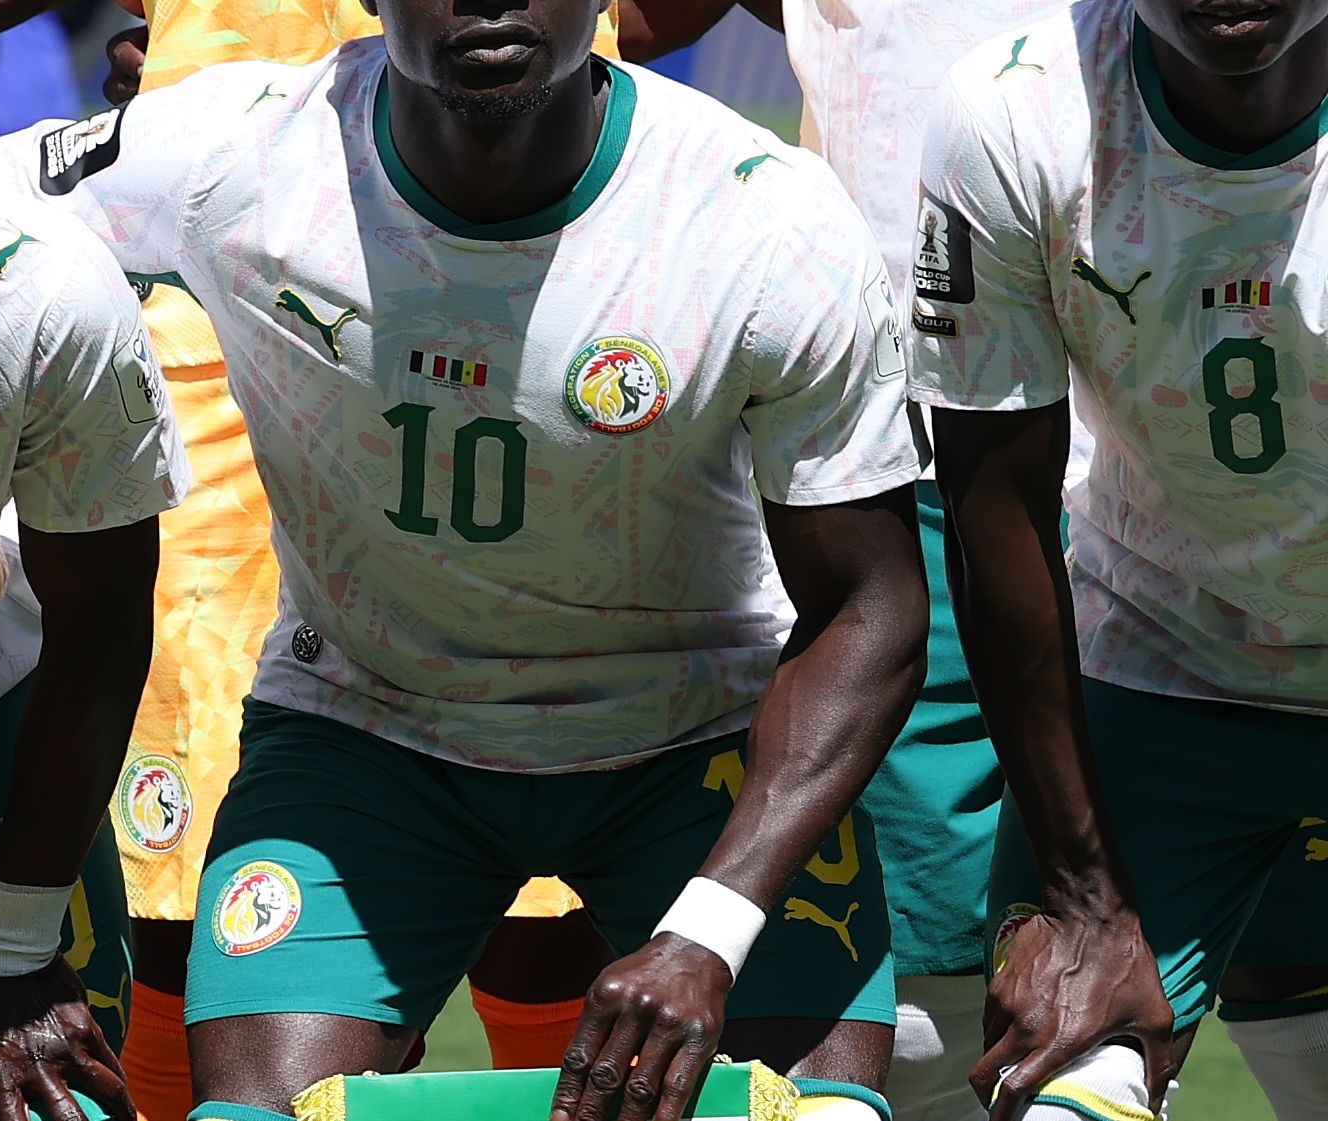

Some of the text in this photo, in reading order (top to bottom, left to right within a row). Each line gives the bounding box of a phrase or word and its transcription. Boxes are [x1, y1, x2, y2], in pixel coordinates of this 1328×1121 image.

[919, 253, 940, 265] FIFA
[934, 272, 951, 281] CUP
[915, 278, 951, 293] 026
[1202, 335, 1287, 475] 8
[381, 400, 528, 544] 10
